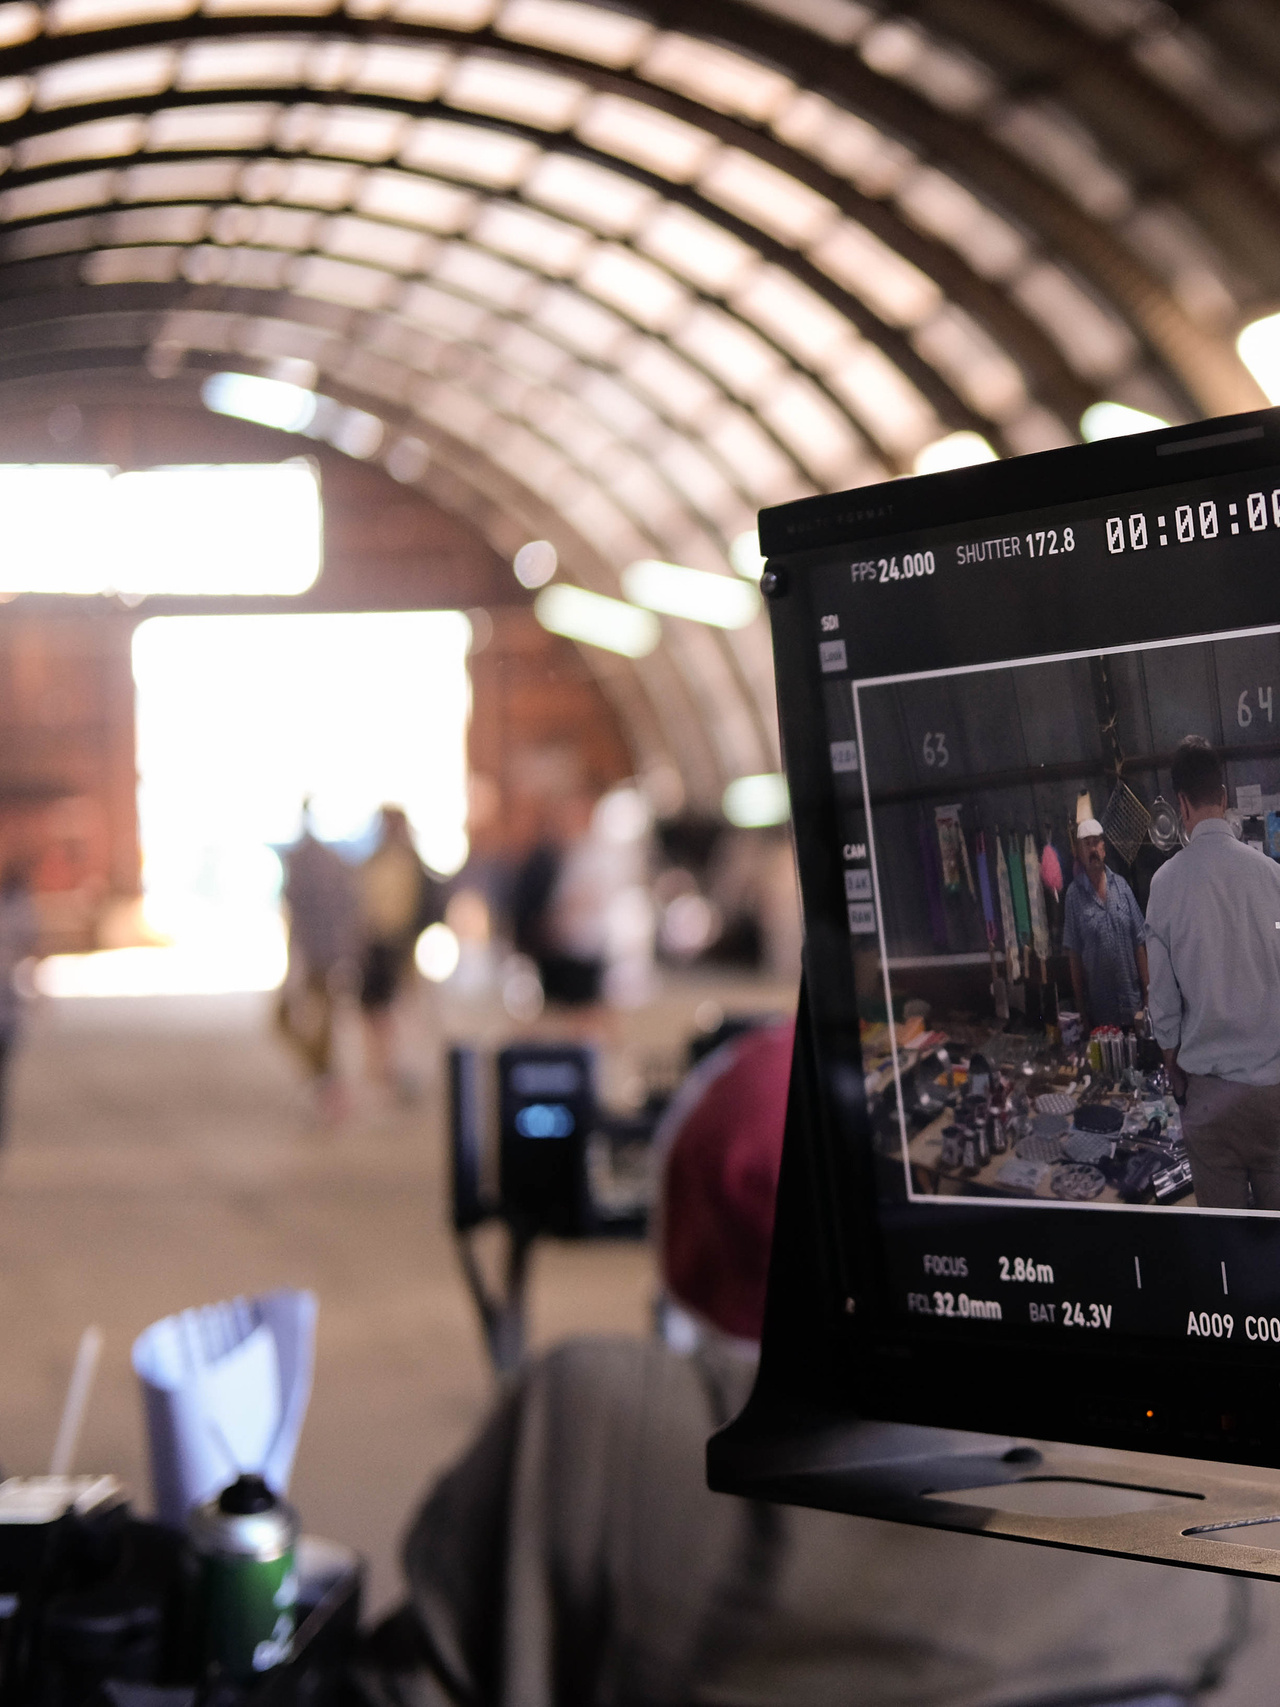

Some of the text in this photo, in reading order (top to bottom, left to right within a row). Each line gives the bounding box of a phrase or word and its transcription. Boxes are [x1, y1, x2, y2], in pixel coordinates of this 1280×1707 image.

[956, 527, 1077, 566] SHUTTER 172.8
[850, 550, 936, 584] FPS 24.000
[820, 613, 839, 632] SDI
[1236, 686, 1274, 728] 64
[922, 731, 950, 767] 63
[843, 843, 867, 861] CAM
[923, 1254, 1055, 1283] FOCUS 2.86m
[933, 1291, 1003, 1321] 32.0mm
[1029, 1301, 1113, 1329] BAT 24.3V
[1187, 1310, 1235, 1339] A009
